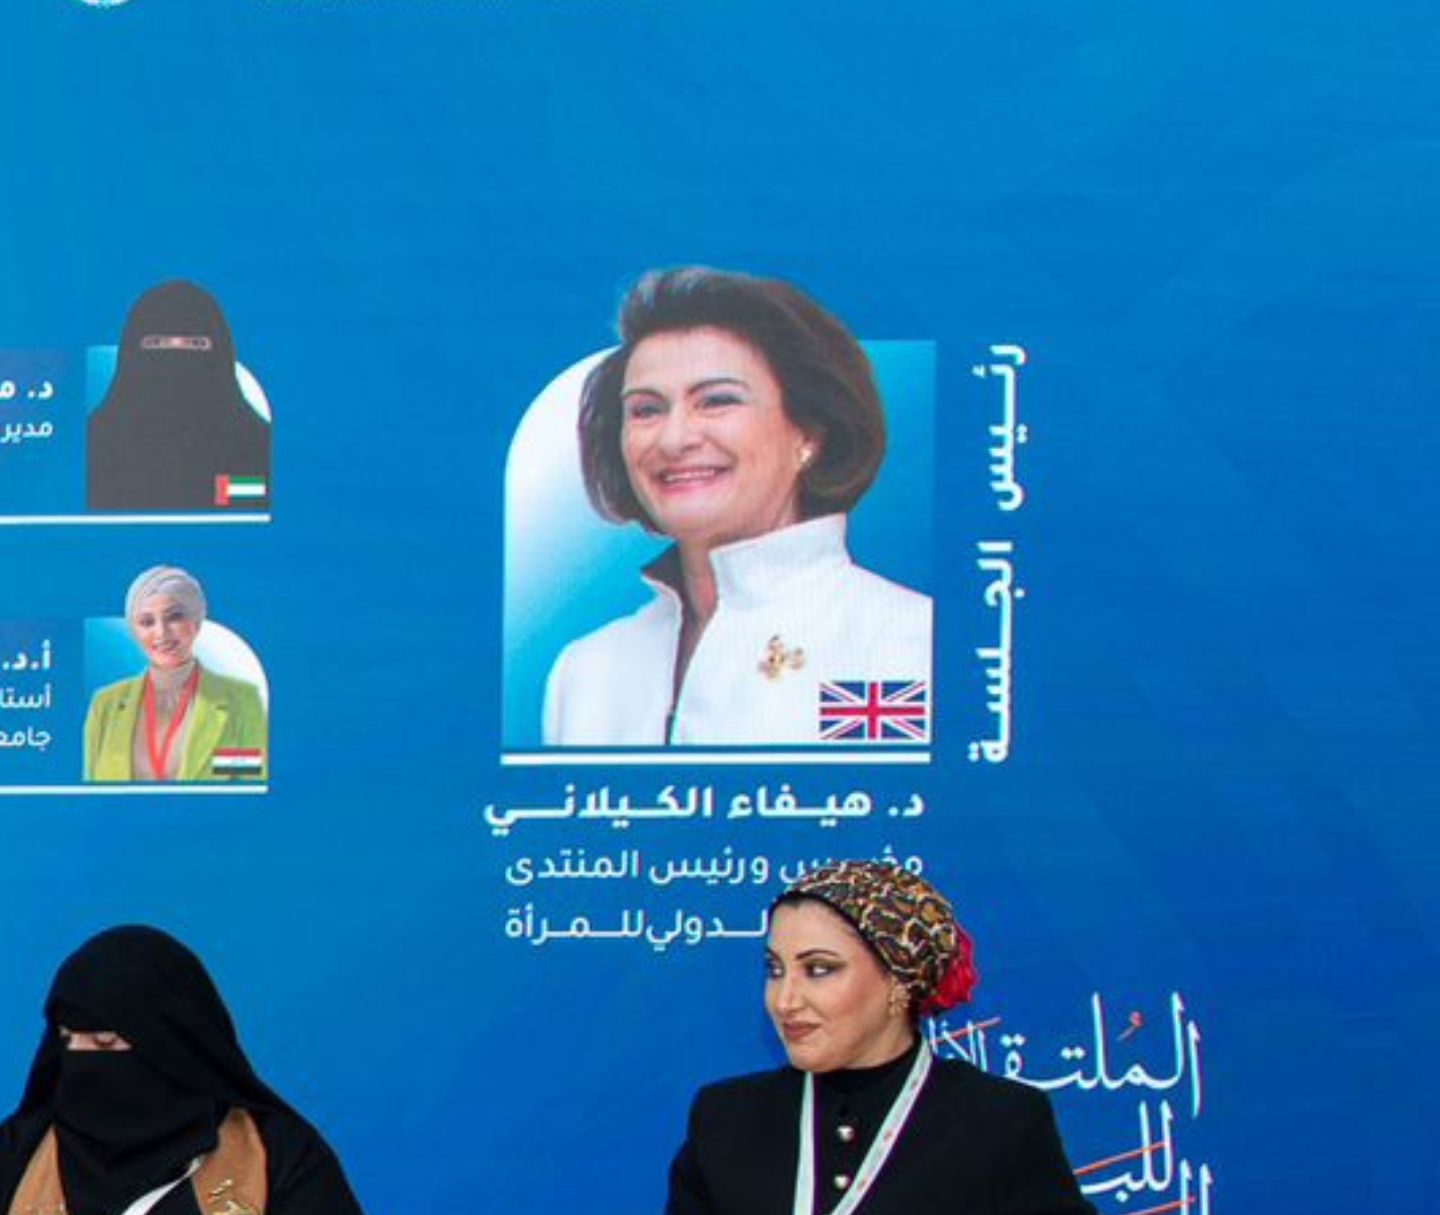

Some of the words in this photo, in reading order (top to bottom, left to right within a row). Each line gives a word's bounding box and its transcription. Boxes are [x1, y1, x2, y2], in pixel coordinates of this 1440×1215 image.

[0, 421, 54, 444] مدير
[972, 344, 1028, 511] رئيس
[969, 541, 1026, 763] الجلسة
[484, 784, 714, 836] الكيلاني
[727, 784, 873, 827] هيفاء
[505, 849, 640, 886] المنتدى
[649, 846, 770, 885] ورئيس
[505, 903, 645, 946] للمرأة
[645, 909, 768, 952] لدولي
